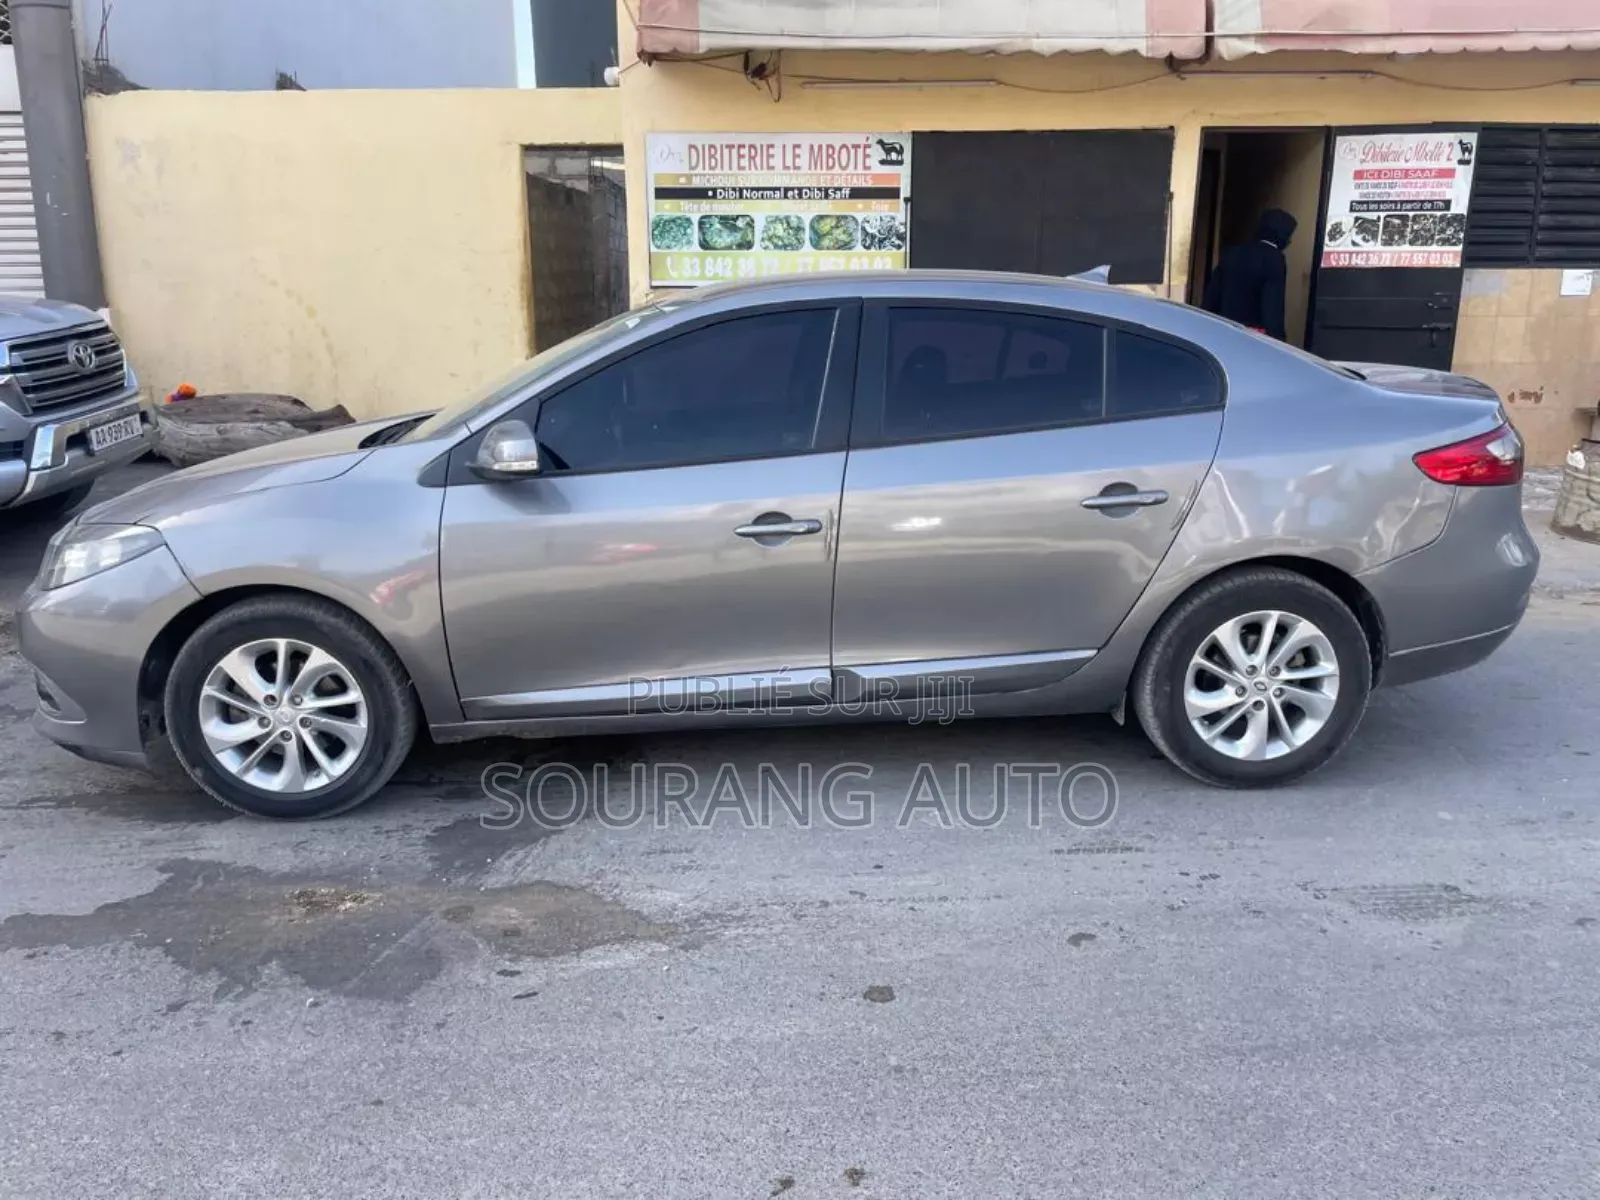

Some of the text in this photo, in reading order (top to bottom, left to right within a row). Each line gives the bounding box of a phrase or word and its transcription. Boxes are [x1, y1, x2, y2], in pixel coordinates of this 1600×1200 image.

[688, 143, 775, 171] DIBITERIE
[782, 143, 801, 171] LE
[807, 136, 872, 171] MBOTÉ
[1446, 141, 1454, 162] 2
[1380, 170, 1405, 179] DIBI
[1407, 169, 1439, 178] SAAF
[716, 187, 851, 199] Dibi Normal et Dibi Saff
[1352, 202, 1367, 211] Tous
[1422, 201, 1432, 209] de
